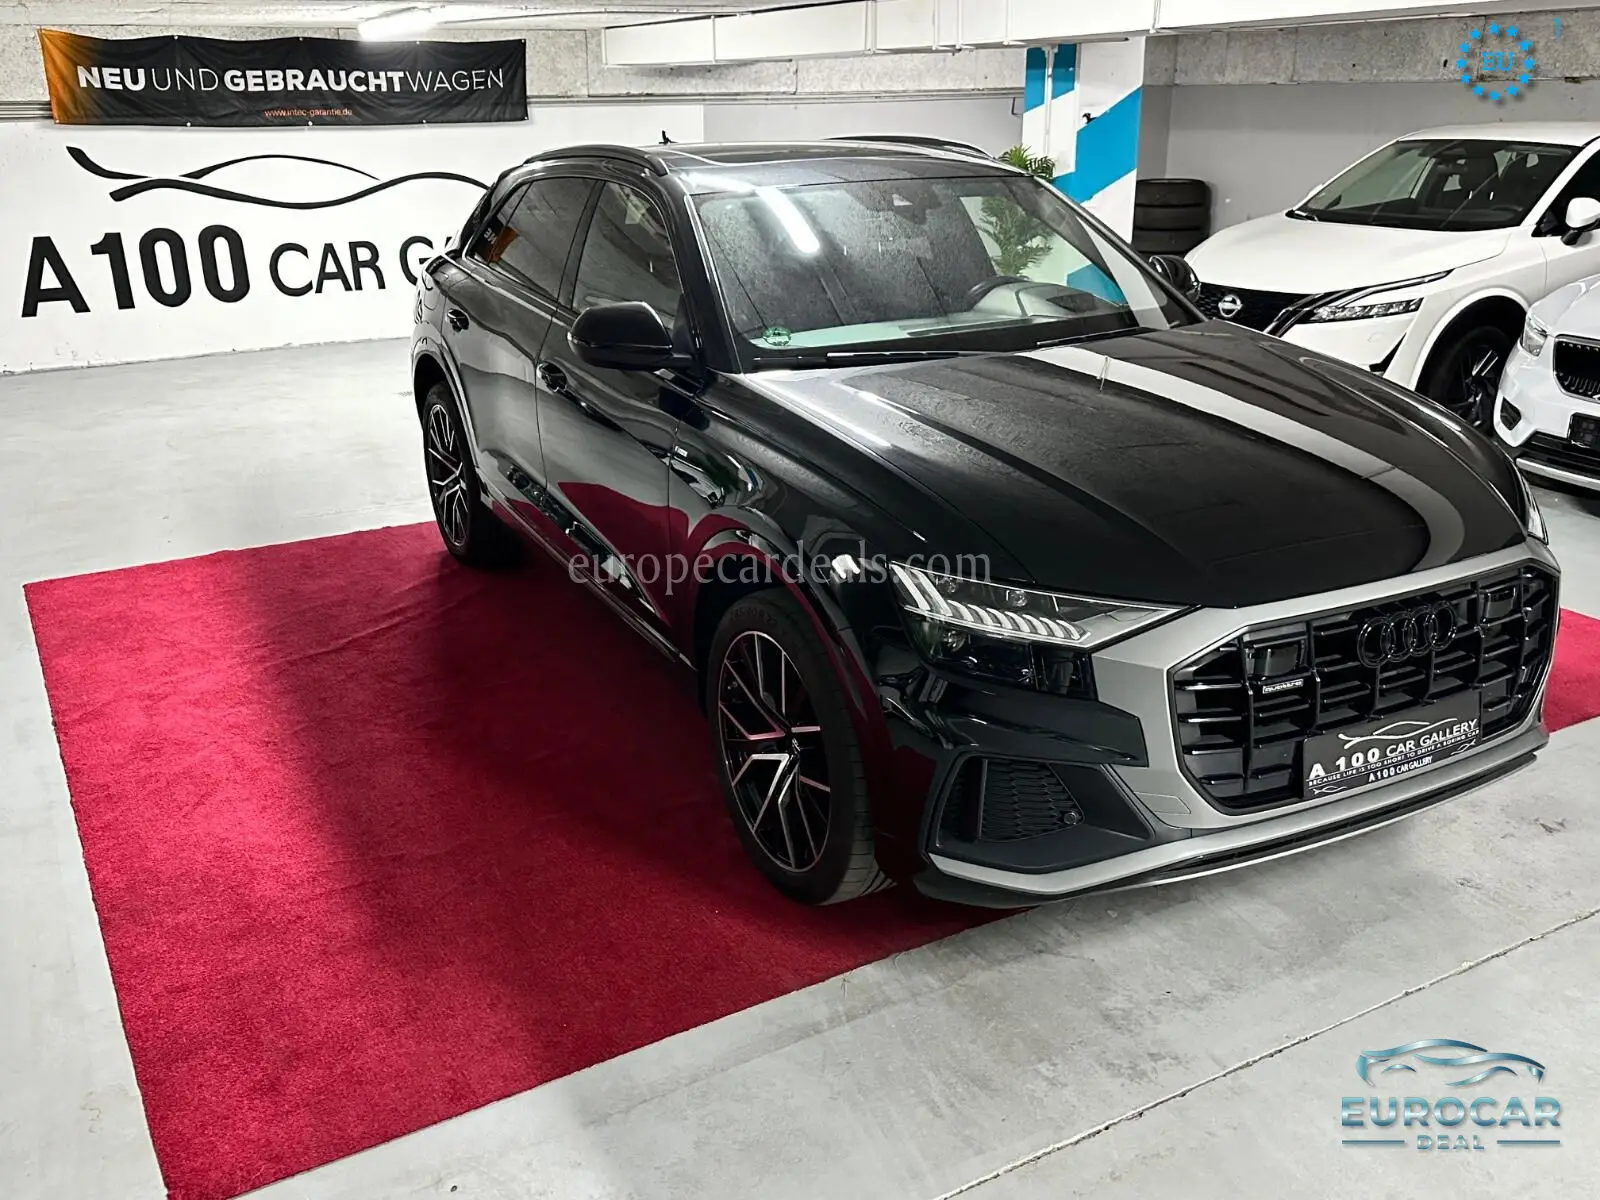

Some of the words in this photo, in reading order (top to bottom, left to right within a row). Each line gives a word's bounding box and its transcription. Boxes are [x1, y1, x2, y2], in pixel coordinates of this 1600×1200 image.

[264, 108, 353, 118] www.intec-garantie.de
[269, 241, 386, 297] CAR
[1308, 774, 1341, 787] BECAUSE
[1343, 769, 1357, 777] LIFE
[1367, 761, 1382, 770] TOO
[1383, 753, 1405, 765] SHORT
[1406, 751, 1416, 759] TO
[1417, 744, 1435, 754] DRIVE
[1443, 734, 1466, 746] BORING
[1386, 740, 1416, 758] CAR
[1419, 718, 1478, 747] GALLERY
